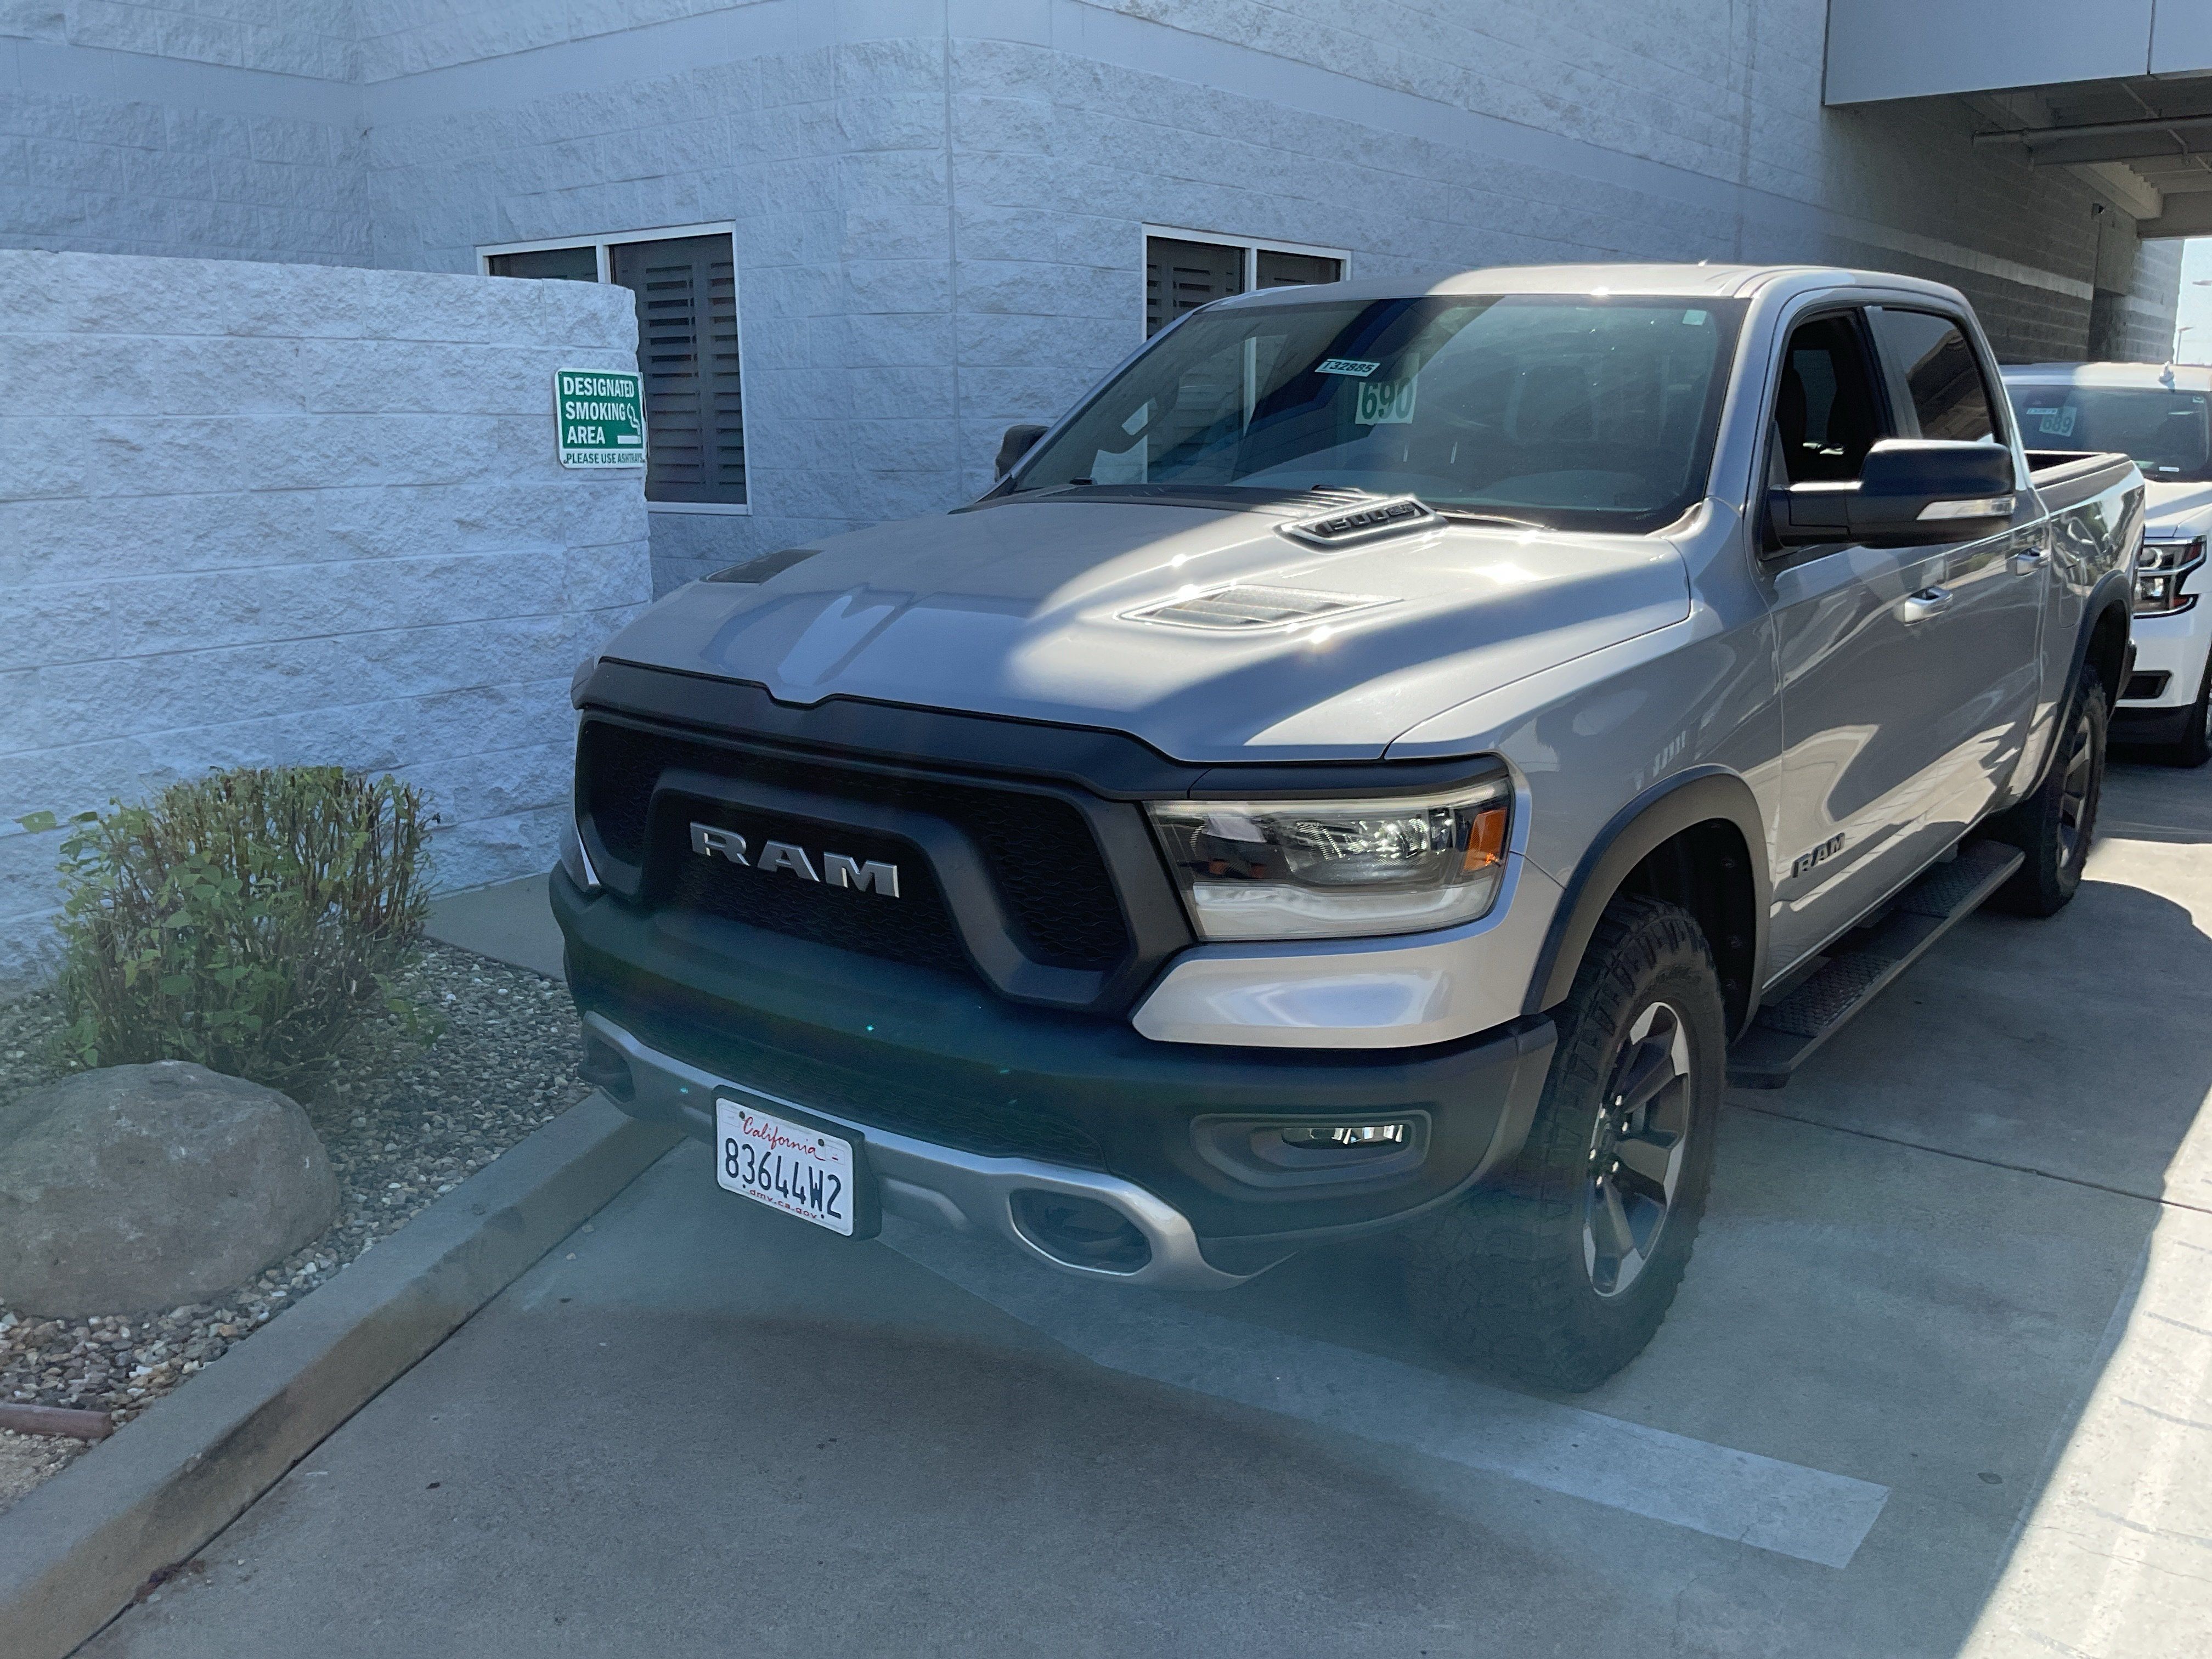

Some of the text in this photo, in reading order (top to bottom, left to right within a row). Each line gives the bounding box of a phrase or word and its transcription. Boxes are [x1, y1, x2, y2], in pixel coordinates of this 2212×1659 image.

[1323, 360, 1375, 373] T32885
[563, 376, 635, 398] DESIGNATED
[1361, 377, 1413, 420] 690
[565, 401, 627, 421] SMOKING
[567, 426, 606, 444] AREA
[567, 453, 600, 464] PLEASE
[601, 453, 617, 464] USE
[690, 822, 900, 899] RAM
[1791, 832, 1845, 878] RAM
[743, 1116, 826, 1161] California
[725, 1137, 842, 1219] 83644W2
[749, 1189, 817, 1219] dmv.ca.gov
